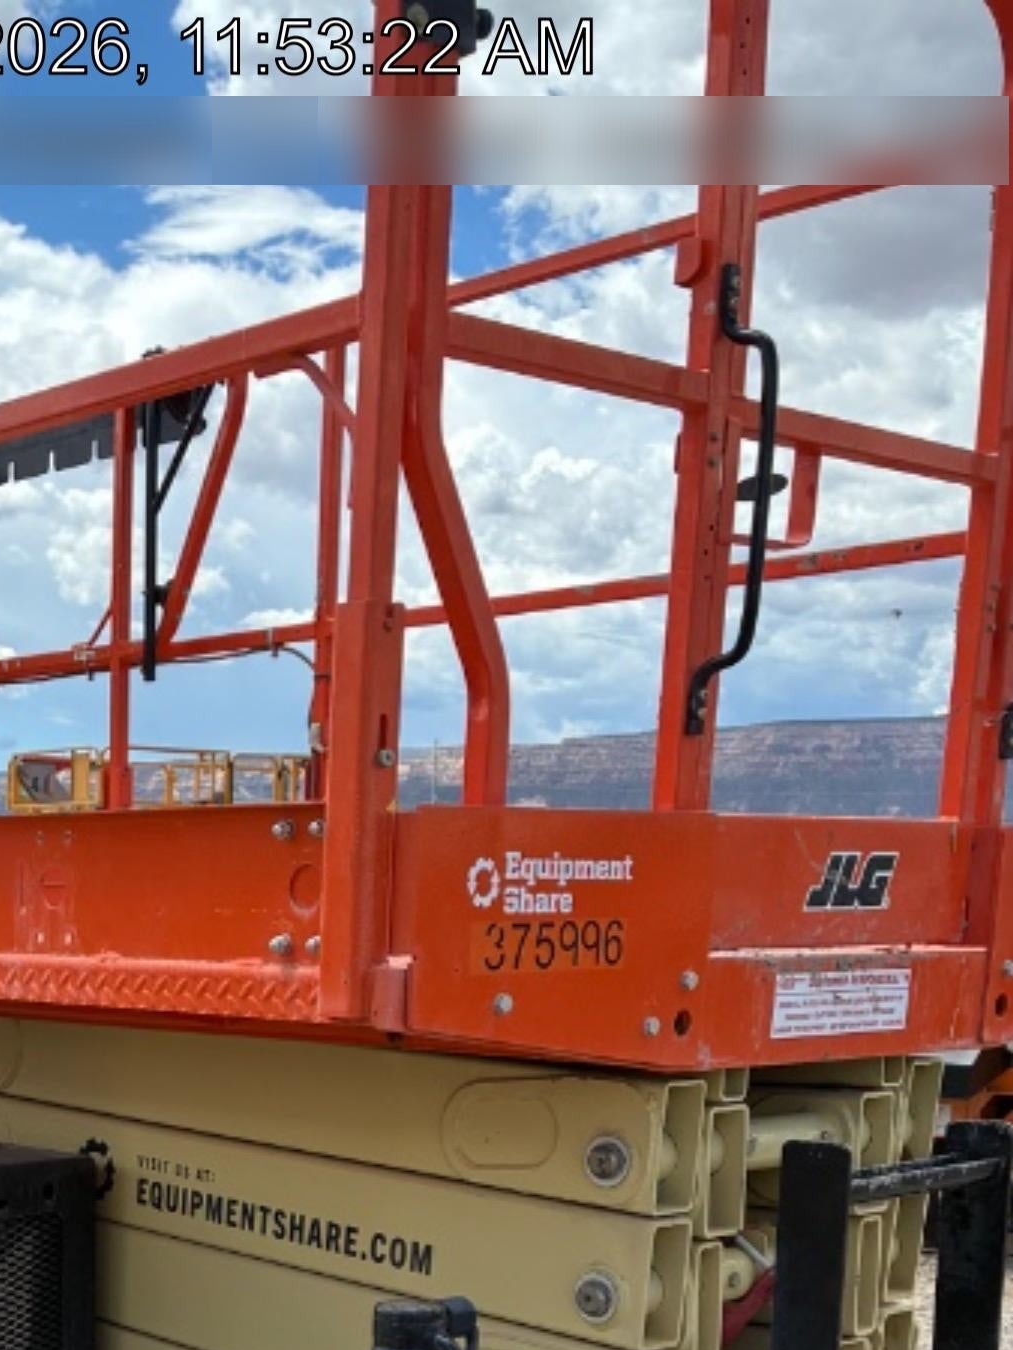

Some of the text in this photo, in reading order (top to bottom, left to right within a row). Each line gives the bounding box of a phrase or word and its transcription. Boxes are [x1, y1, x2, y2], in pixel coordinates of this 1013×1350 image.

[504, 852, 633, 885] Equipment
[804, 852, 898, 910] JLG
[503, 886, 573, 914] Share
[484, 920, 624, 971] 375996
[137, 1155, 168, 1174] VISIT
[136, 1178, 434, 1276] EQUIPMENTSHARE.COM
